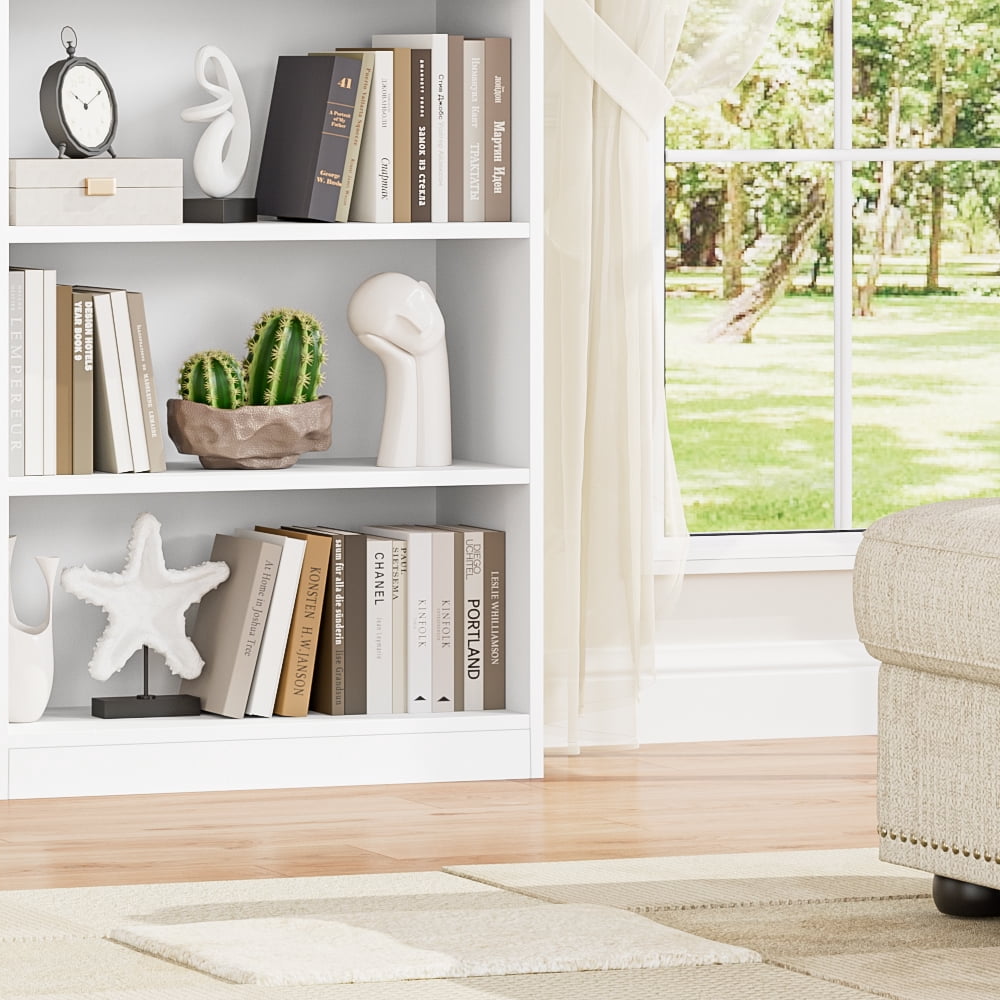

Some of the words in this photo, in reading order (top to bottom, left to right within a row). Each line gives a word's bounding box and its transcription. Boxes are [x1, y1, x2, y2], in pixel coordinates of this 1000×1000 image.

[337, 77, 353, 90] 41
[471, 106, 480, 128] Кант
[491, 121, 505, 162] Мартин
[320, 170, 340, 179] George
[327, 179, 342, 187] Bush
[378, 157, 391, 200] Спартак
[470, 142, 480, 200] ТРАКТАТЫ
[492, 167, 505, 193] Иден
[418, 174, 426, 206] стекла
[74, 301, 82, 325] YEAR
[84, 301, 93, 335] DESIGN
[74, 327, 82, 354] BOOK
[84, 337, 93, 371] HOTELS
[10, 318, 22, 450] LEMPEREUR
[335, 539, 343, 560] saum
[465, 539, 474, 580] UCHITEL
[473, 543, 481, 574] DIEGO
[264, 559, 274, 571] At
[335, 563, 344, 576] für
[374, 552, 385, 606] CHANEL
[392, 547, 400, 600] SIETSEMA
[258, 572, 271, 597] Home
[304, 566, 322, 619] KONSTEN
[335, 577, 344, 592] alla
[335, 593, 344, 606] die
[490, 571, 499, 600] LESLIE
[256, 598, 264, 607] in
[249, 608, 263, 637] Joshua
[335, 606, 344, 645] sünderin
[418, 599, 427, 648] KINFOLK
[441, 599, 451, 648] KINFOLK
[244, 639, 257, 657] Tree
[467, 599, 480, 680] PORTLAND
[335, 667, 343, 706] Grandsun
